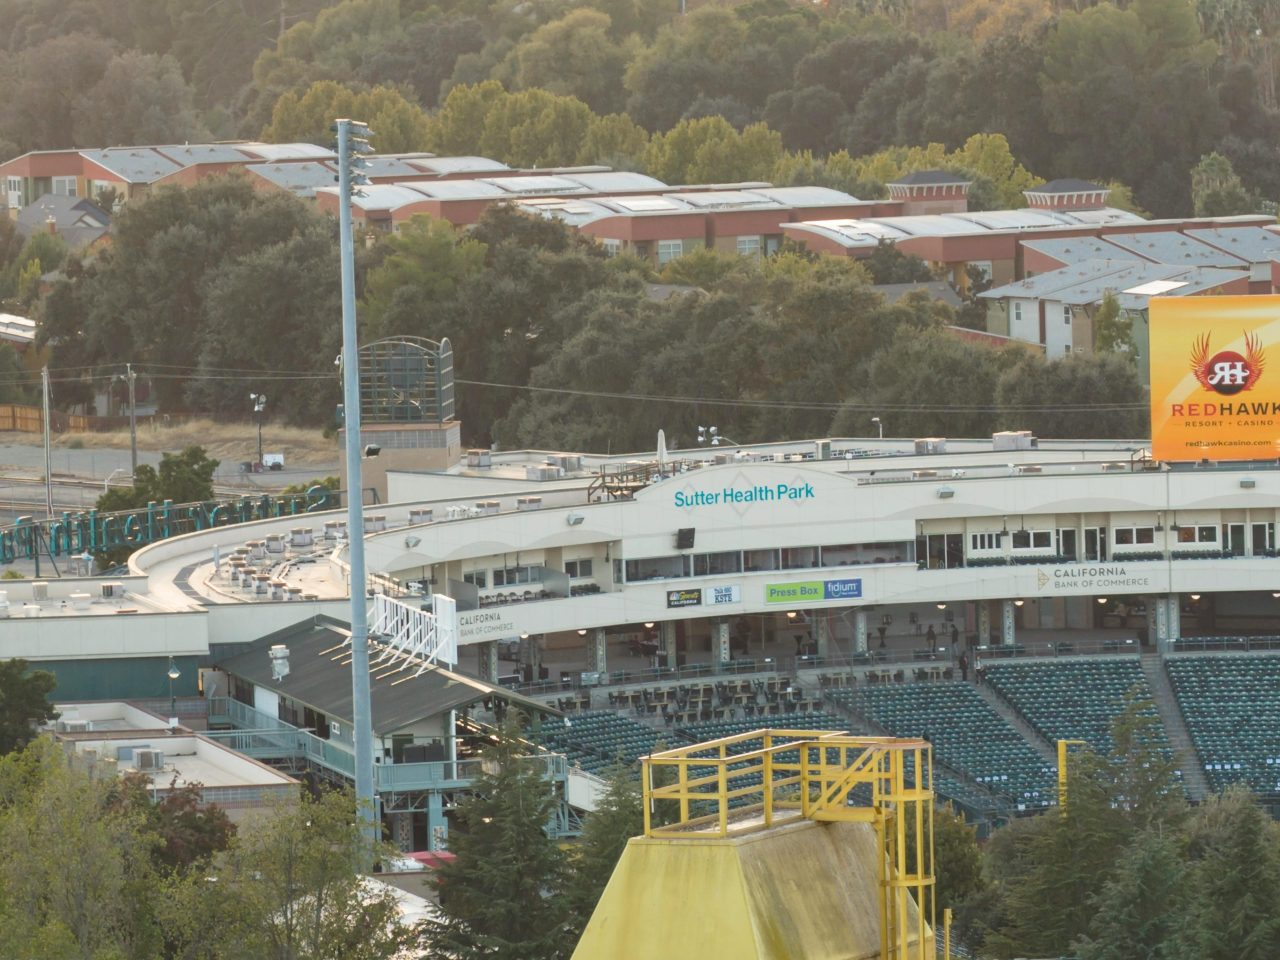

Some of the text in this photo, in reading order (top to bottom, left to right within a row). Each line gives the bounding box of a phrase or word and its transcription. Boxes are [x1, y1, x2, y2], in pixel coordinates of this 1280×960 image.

[674, 483, 816, 507] Sutter Health Park
[1054, 567, 1127, 577] CALIFORNIA
[1081, 579, 1094, 587] OF
[1097, 578, 1149, 586] COMMERCE
[770, 586, 819, 597] Press Box
[460, 612, 501, 625] CALIFORNIA
